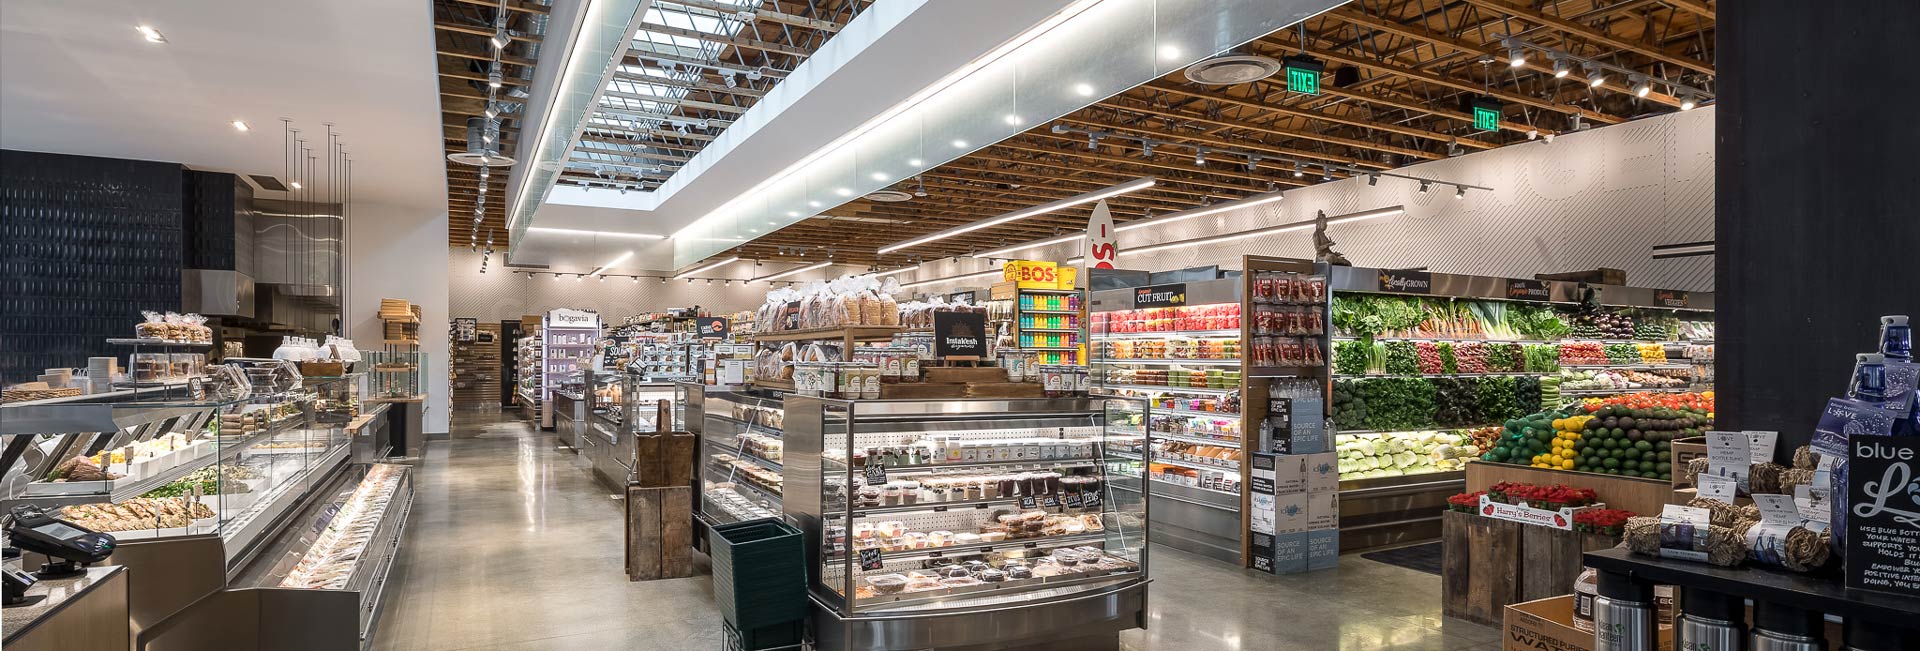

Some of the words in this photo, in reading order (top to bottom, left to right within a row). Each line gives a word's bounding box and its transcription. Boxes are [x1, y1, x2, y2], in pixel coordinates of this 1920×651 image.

[1137, 294, 1152, 303] CUT
[1152, 291, 1173, 301] FRUIT
[558, 312, 589, 324] bogavia
[1293, 422, 1316, 430] SOURCE
[1856, 441, 1914, 461] blue
[1496, 507, 1522, 518] Harry's
[1523, 511, 1552, 522] Berries
[1878, 527, 1897, 535] BLUE
[1866, 533, 1889, 541] YOUR
[1890, 536, 1917, 544] WATER
[1277, 540, 1301, 549] SOURCE
[1862, 541, 1903, 550] SUPPORTS
[1878, 548, 1905, 558] HOLDS
[1871, 563, 1910, 573] EMPOWER
[1864, 569, 1900, 579] POSITIVE
[1863, 577, 1893, 587] DOING,
[1894, 580, 1910, 588] YOU
[1510, 624, 1558, 646] STRUCTURED
